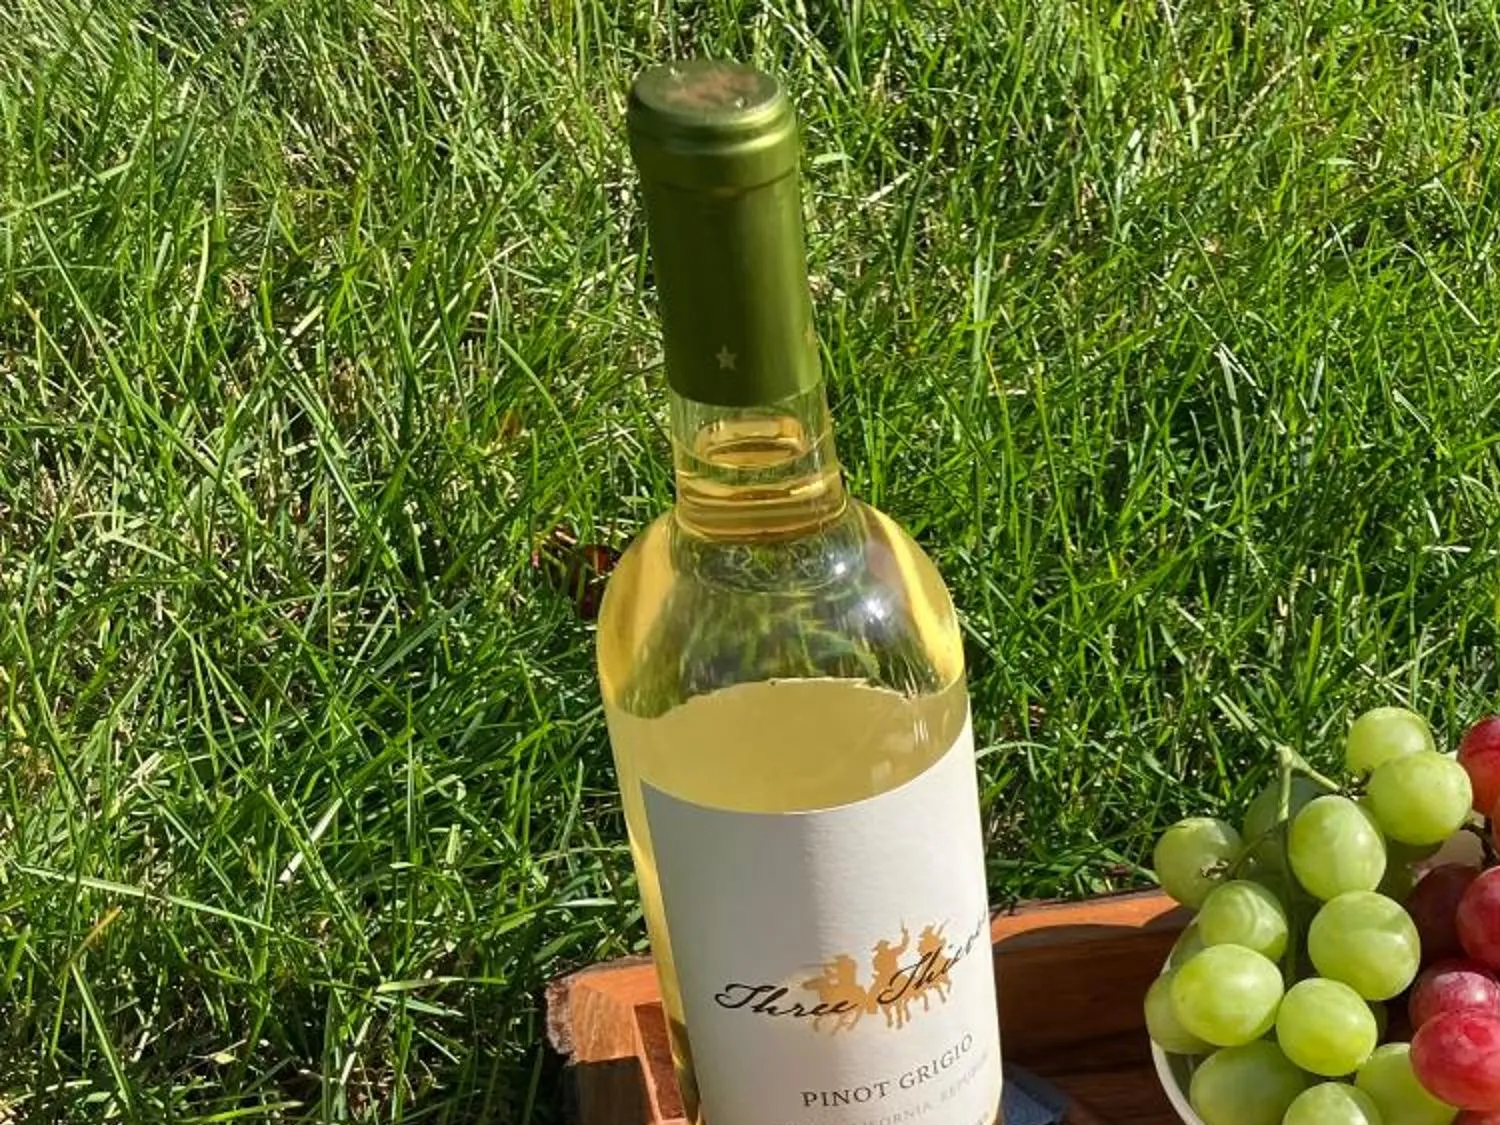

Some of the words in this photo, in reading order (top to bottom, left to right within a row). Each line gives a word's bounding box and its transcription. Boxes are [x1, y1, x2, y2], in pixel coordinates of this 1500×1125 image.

[714, 983, 858, 1017] Three
[800, 1081, 891, 1108] PINOT
[898, 1033, 974, 1090] GRIGIO
